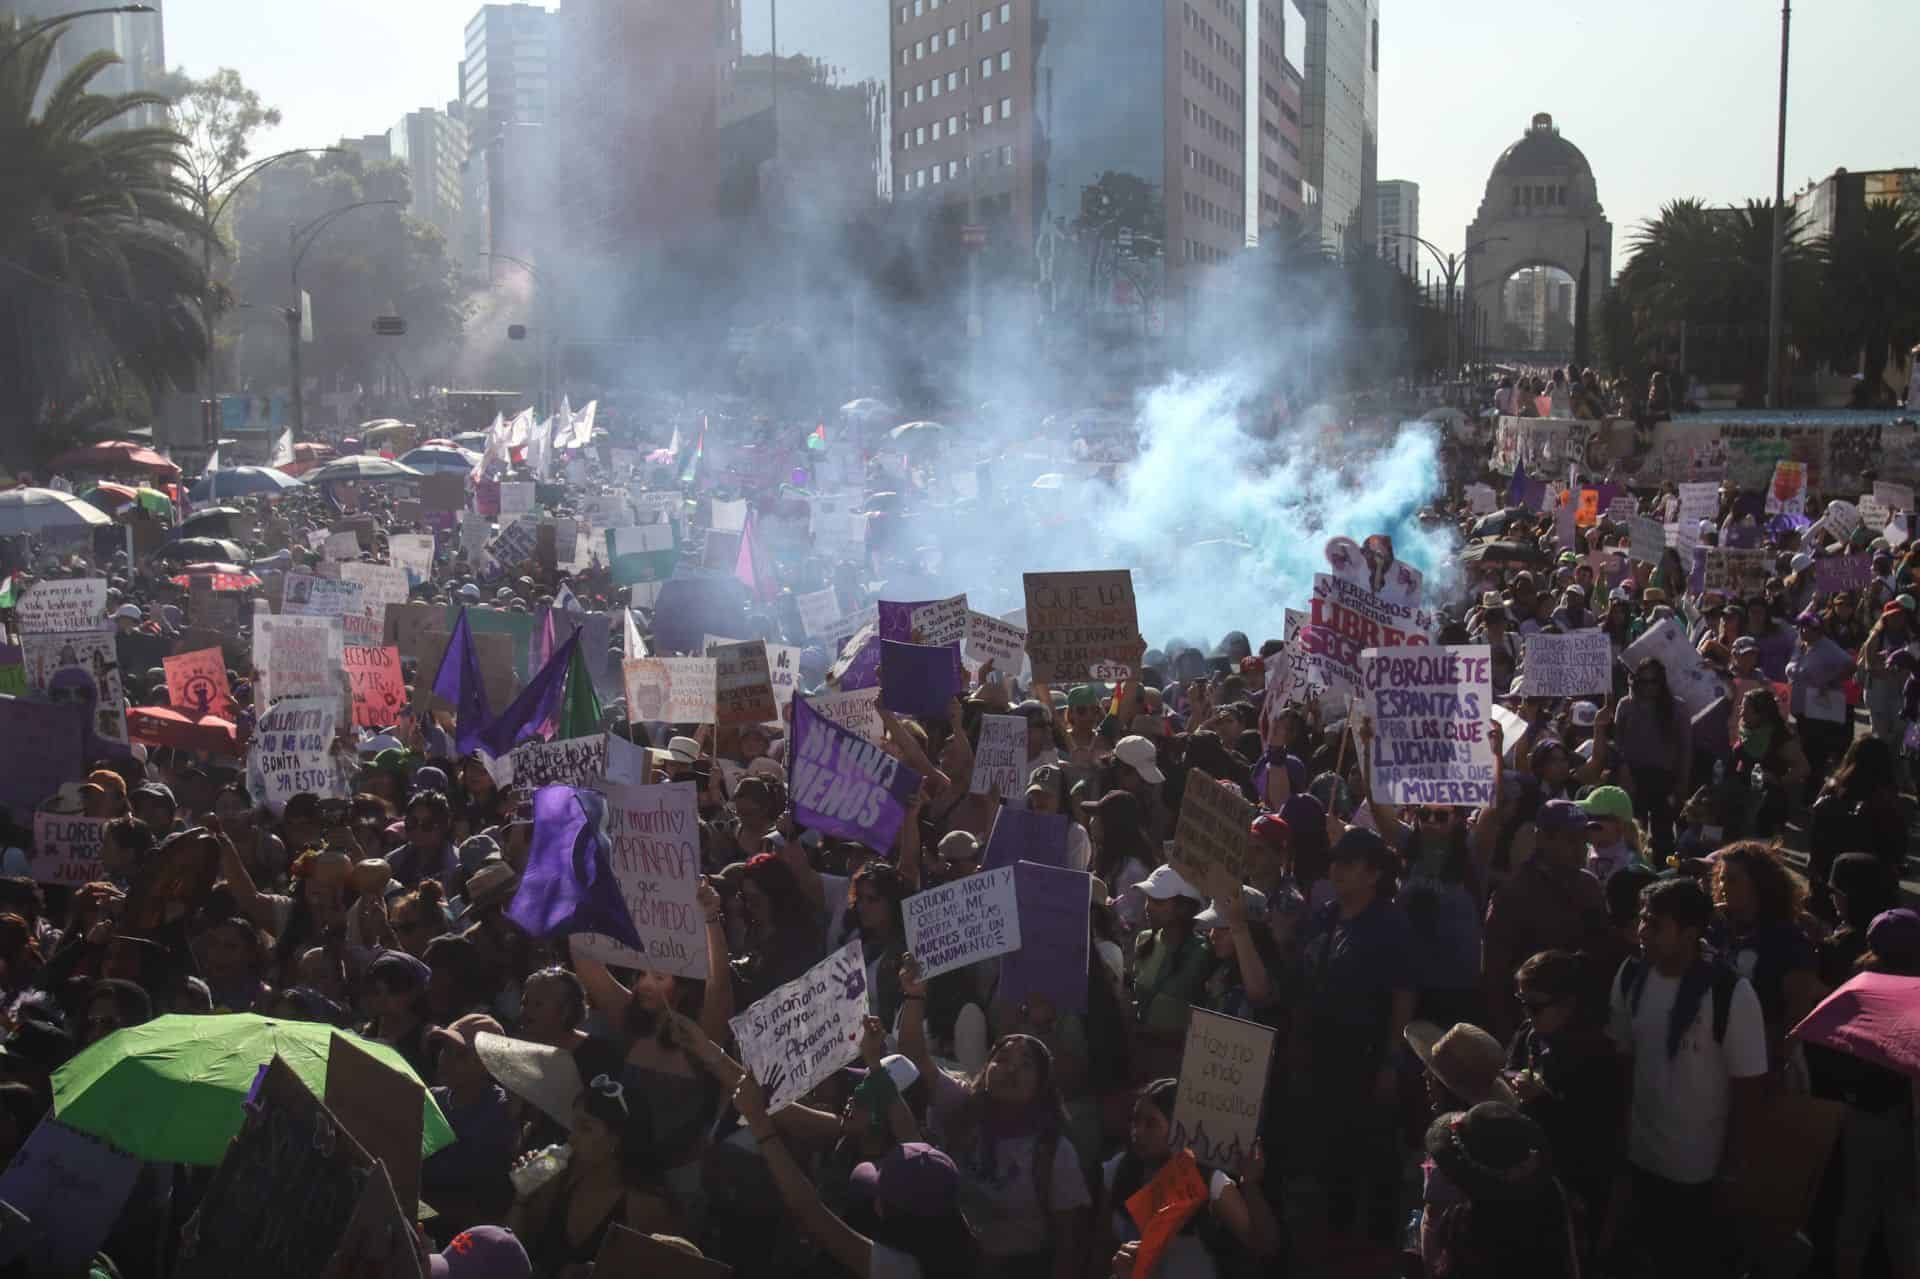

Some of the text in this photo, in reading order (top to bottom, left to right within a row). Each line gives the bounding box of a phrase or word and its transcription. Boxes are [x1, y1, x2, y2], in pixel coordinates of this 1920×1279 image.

[1332, 575, 1412, 619] MERECEMOS
[343, 646, 392, 668] ECEMOS
[1462, 657, 1489, 684] TE
[1096, 664, 1129, 680] ESTA
[1375, 688, 1480, 719] ESPANTAS
[799, 719, 838, 765] NI
[1379, 719, 1483, 743] POR LAS QUE
[262, 751, 300, 774] BONITA
[1374, 735, 1458, 767] LUCHAN
[276, 773, 292, 792] YA
[1376, 767, 1402, 786] NO
[1440, 766, 1465, 781] LAS
[1467, 765, 1494, 781] QUE
[910, 871, 1011, 916] ESTUDIO ARQUI Y
[966, 895, 984, 912] ME
[914, 917, 1005, 959] MUJERES QUE UN
[915, 920, 952, 944] IMPORTA
[981, 904, 1001, 920] LAS
[926, 934, 995, 971] MONUMENTO
[752, 981, 828, 1039] Si mañana
[774, 1018, 792, 1043] soy
[788, 1027, 846, 1085] mi mamá
[1199, 1059, 1243, 1086] ando
